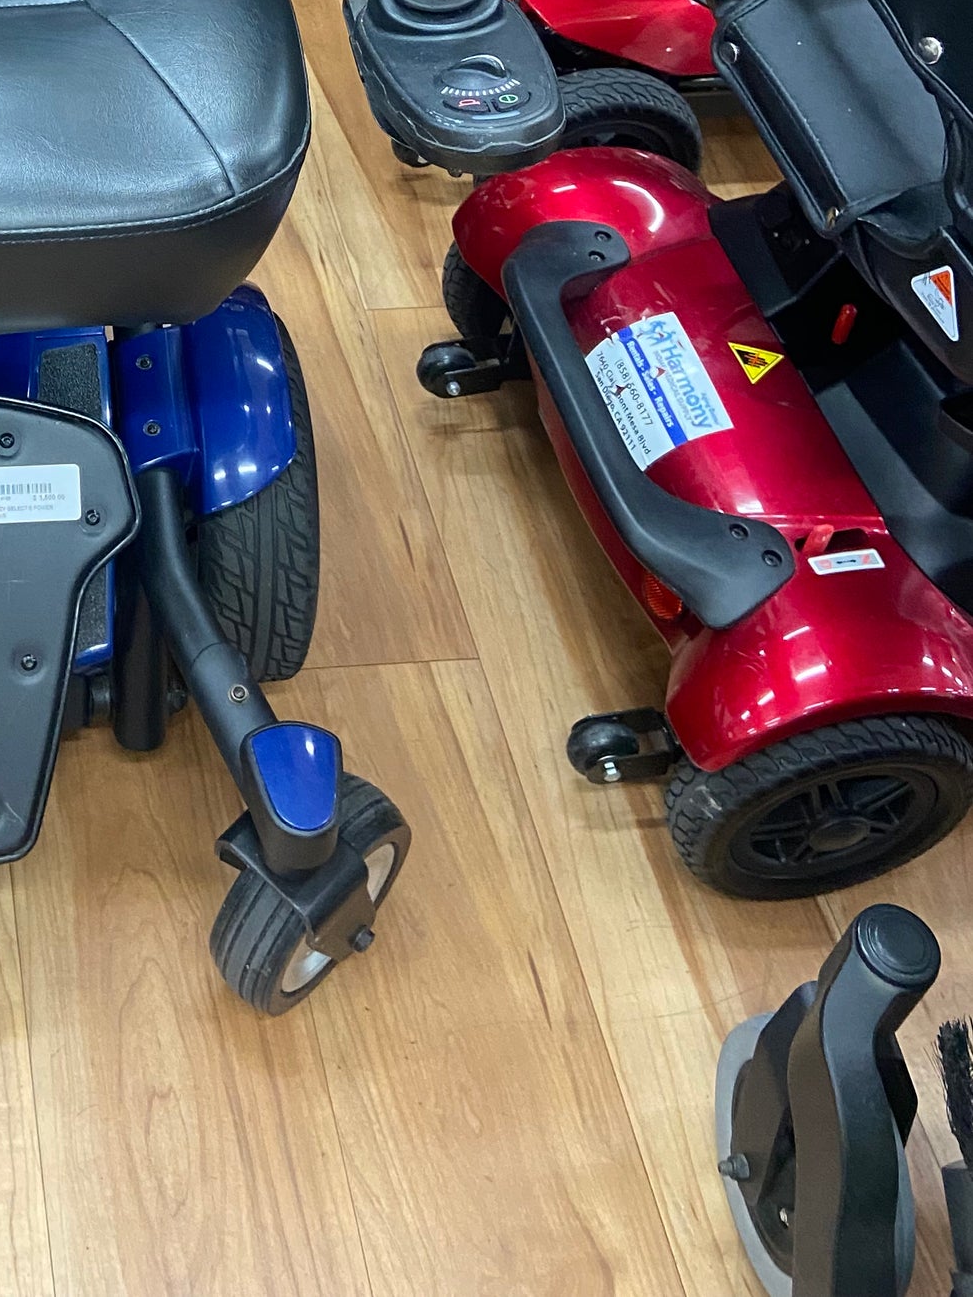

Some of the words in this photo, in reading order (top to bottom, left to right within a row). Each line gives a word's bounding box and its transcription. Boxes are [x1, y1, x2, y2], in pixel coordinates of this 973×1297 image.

[593, 371, 605, 386] San
[612, 411, 623, 424] CA
[618, 424, 636, 450] 92111
[596, 351, 609, 370] 7640
[625, 412, 640, 434] Mesa
[635, 434, 651, 455] Blvd
[613, 358, 631, 383] (858)
[626, 340, 644, 367] Rentals
[652, 396, 674, 428] Repairs
[661, 343, 712, 428] Harmony
